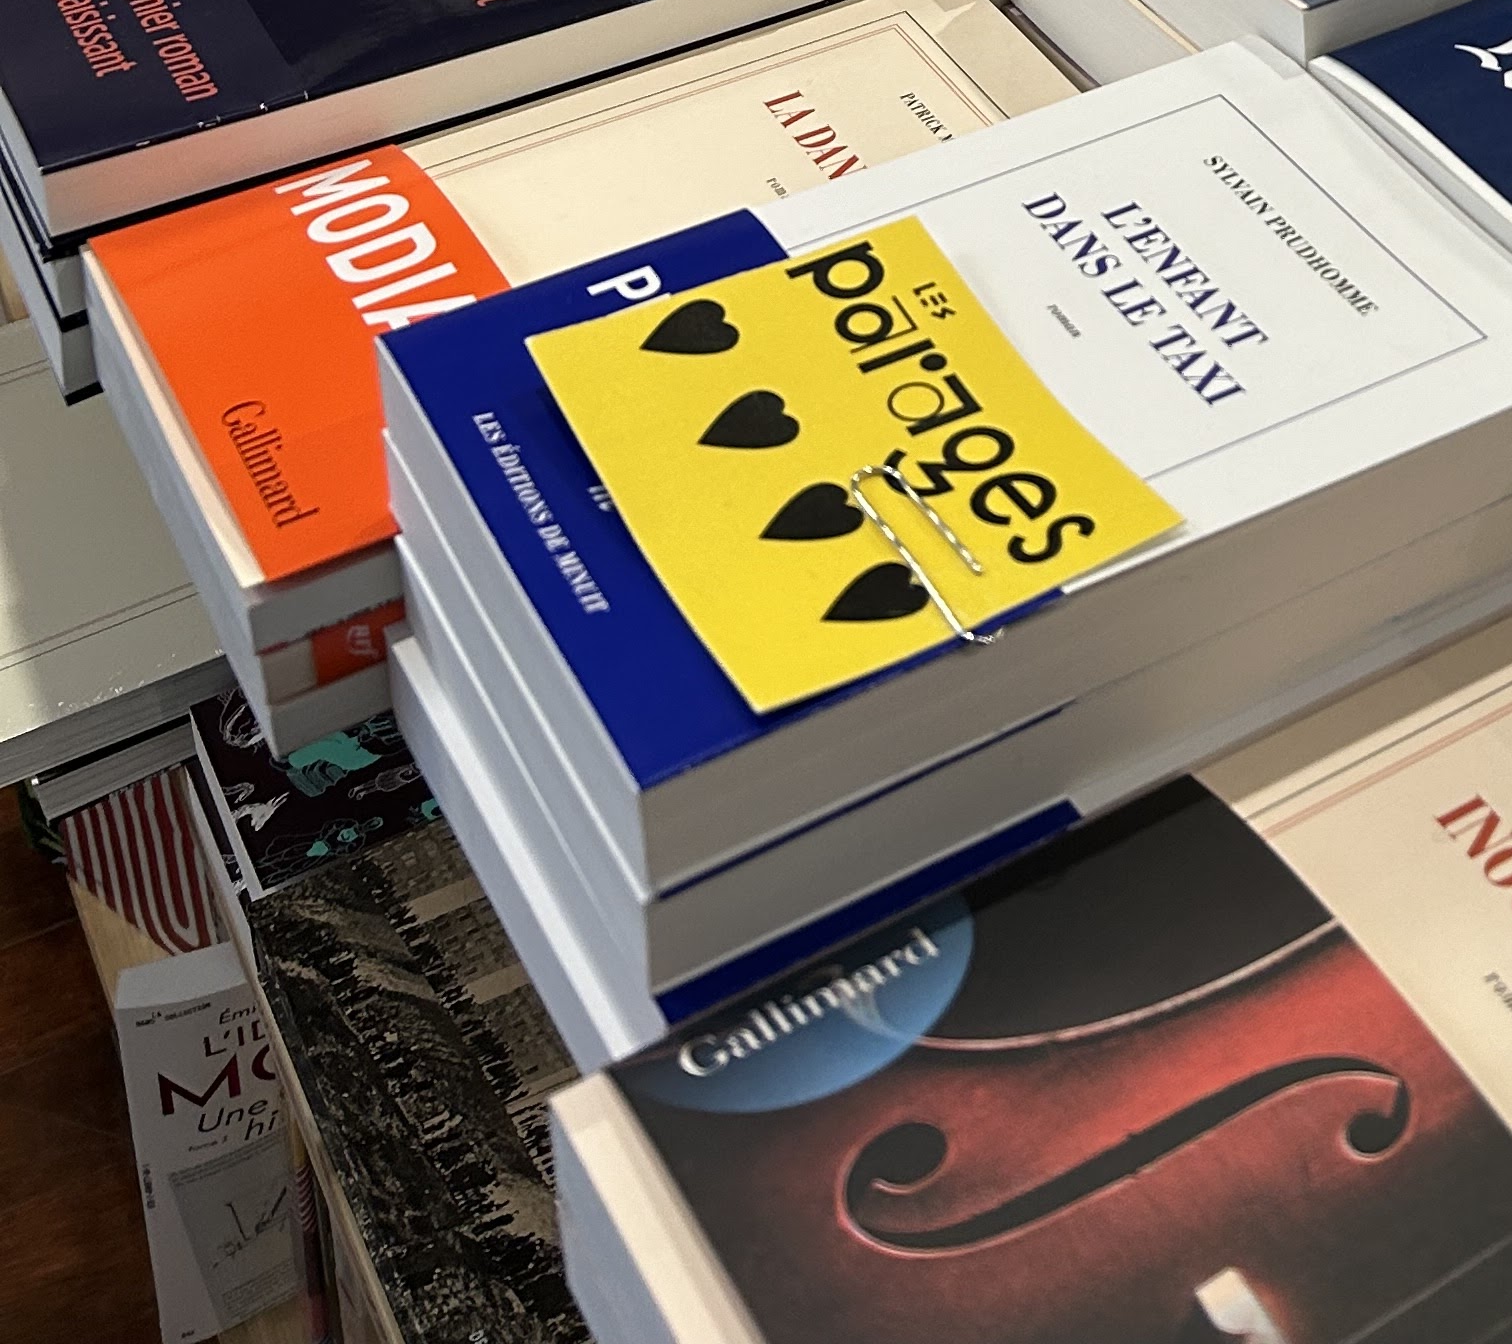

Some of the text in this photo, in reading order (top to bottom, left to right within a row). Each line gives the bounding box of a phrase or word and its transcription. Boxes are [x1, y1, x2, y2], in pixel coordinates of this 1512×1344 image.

[158, 34, 220, 105] roman
[763, 90, 812, 126] LA
[899, 90, 943, 135] PATRICK
[1022, 191, 1250, 410] DANS LE TAXI
[1099, 199, 1272, 358] L'ENFANT
[1201, 153, 1380, 319] SYLVAIN PRUDHOMME
[220, 398, 320, 531] Gallimard
[472, 410, 612, 615] LES ÉDITIONS MINUIT
[676, 922, 943, 1086] Gallimard
